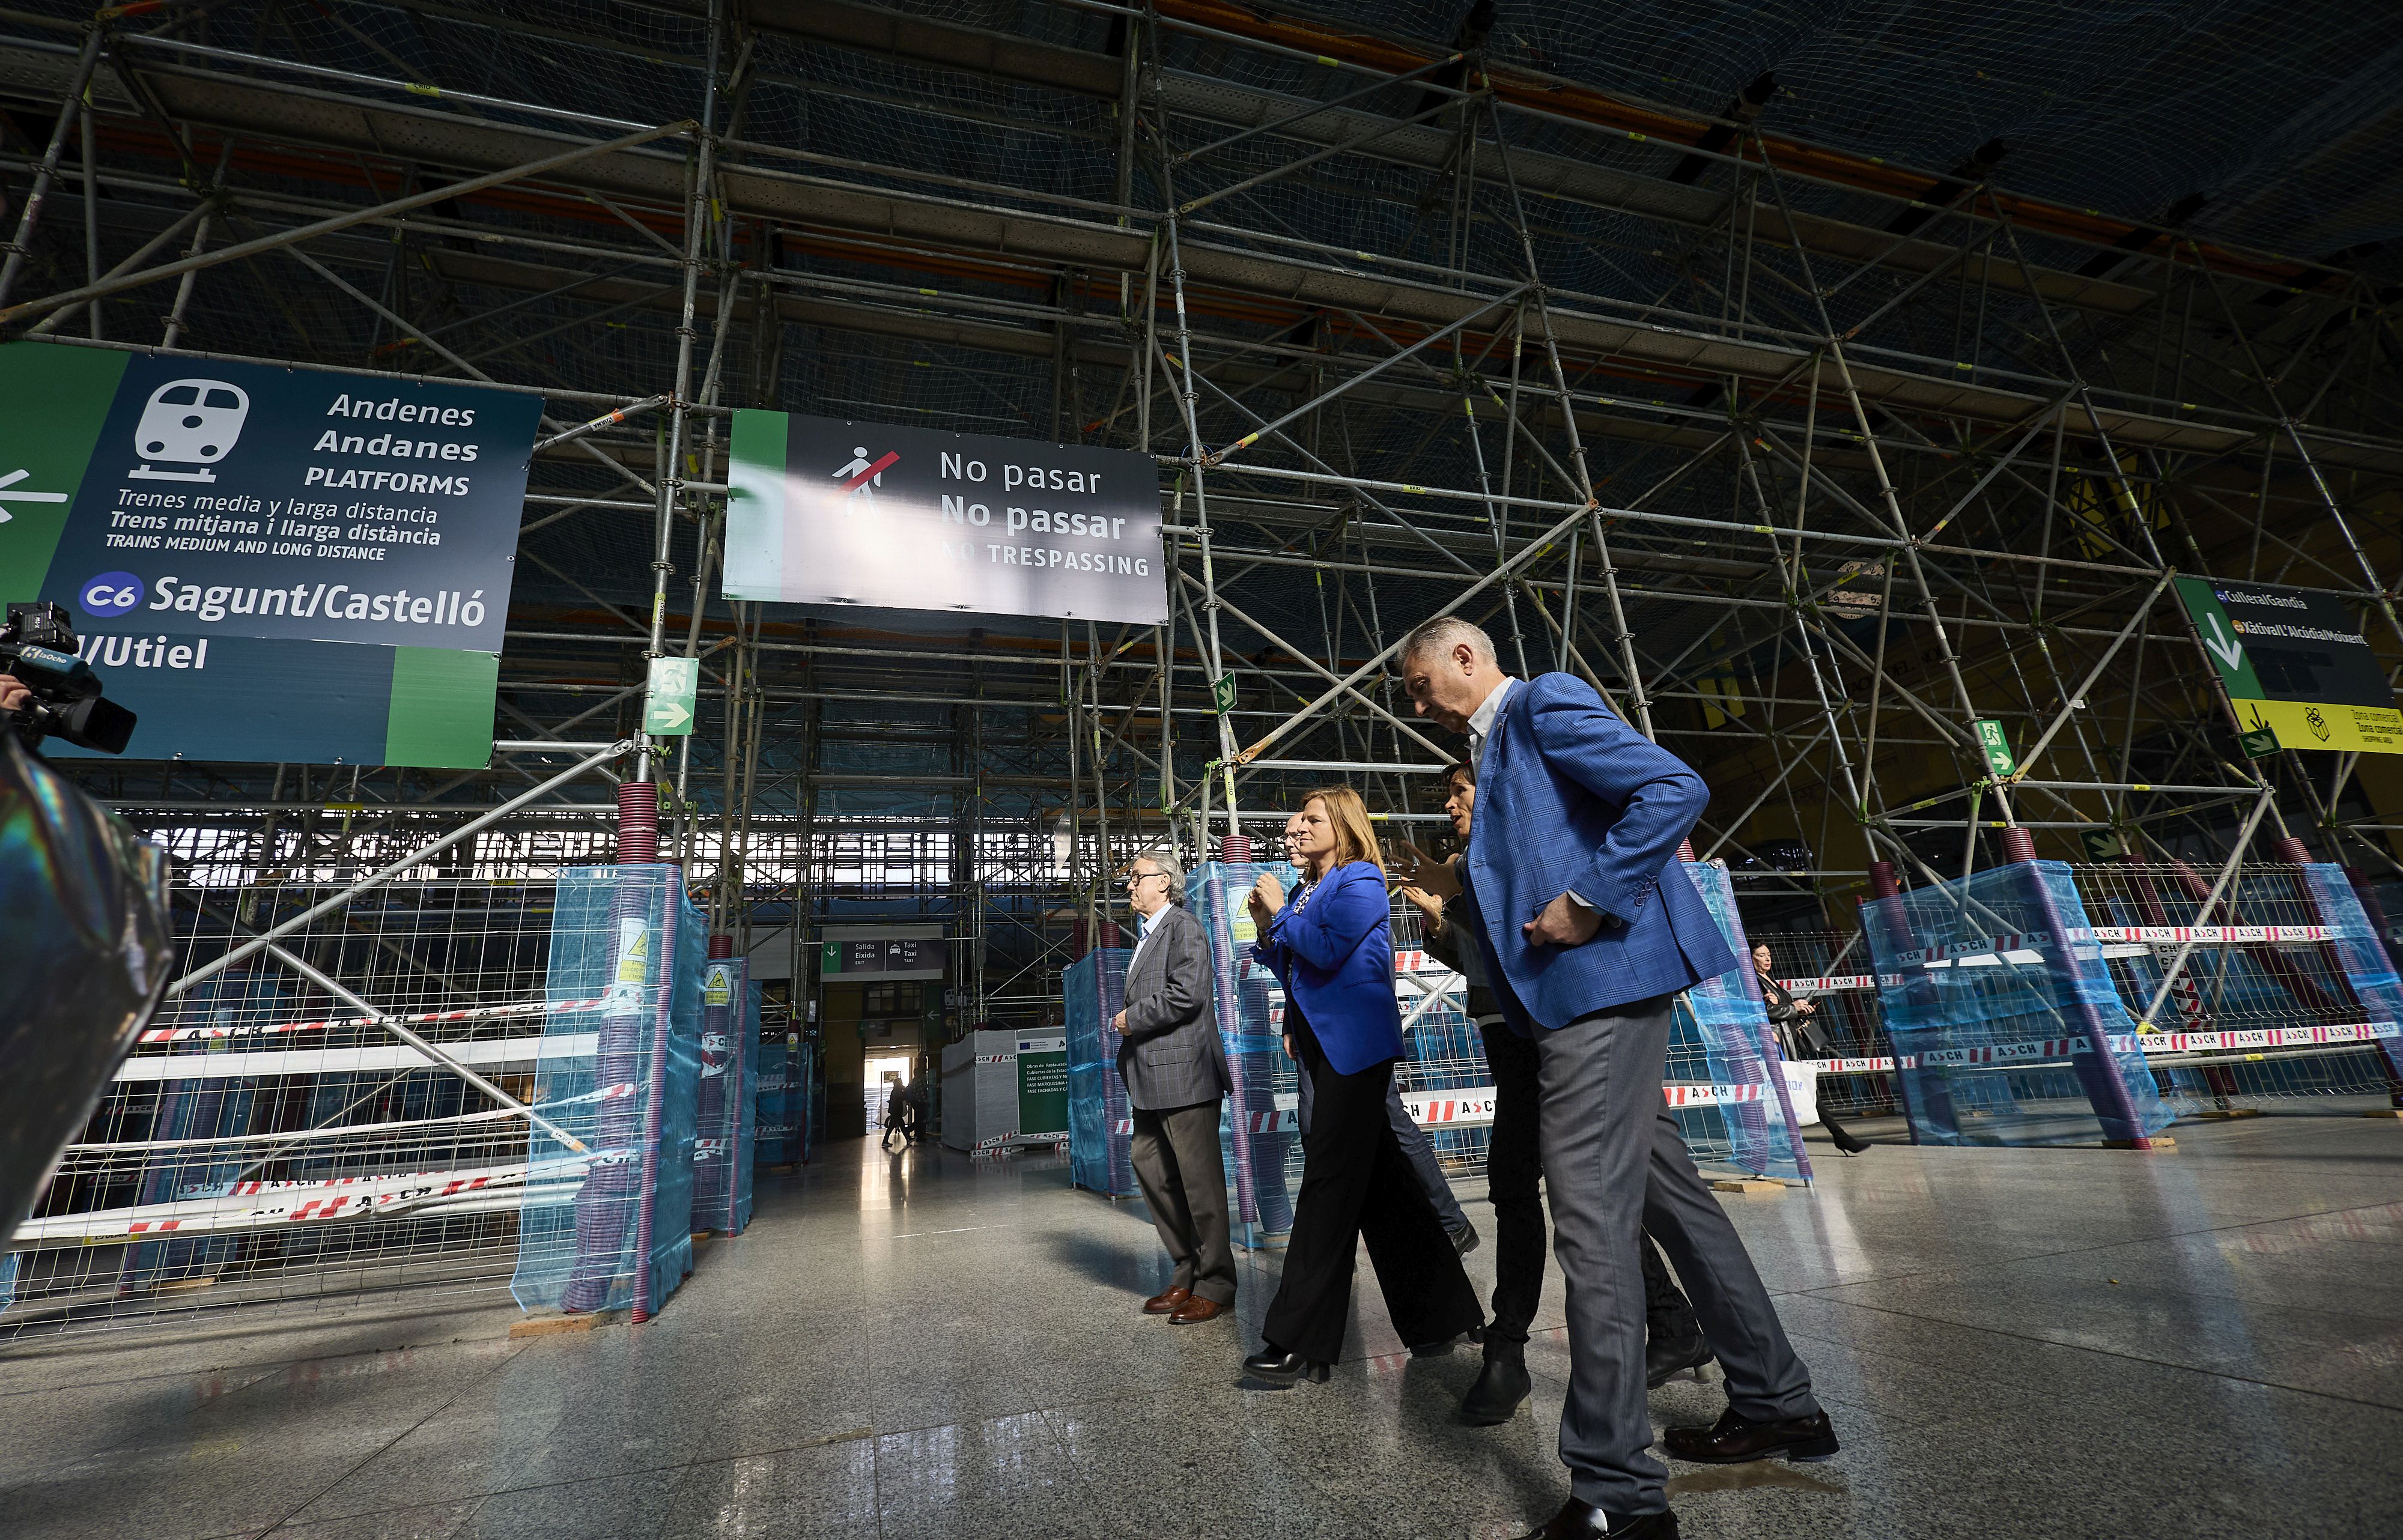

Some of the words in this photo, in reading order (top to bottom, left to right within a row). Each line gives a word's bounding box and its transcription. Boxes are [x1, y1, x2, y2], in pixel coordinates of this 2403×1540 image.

[327, 393, 475, 427] Andenes
[312, 430, 479, 462] Andanes
[305, 467, 470, 497] PLATFORMS
[940, 452, 987, 483] No
[1004, 463, 1101, 494] pasar
[118, 489, 187, 509] Trenes
[193, 494, 261, 512] media
[267, 500, 281, 517] y
[287, 498, 338, 520] larga
[345, 502, 438, 524] distancia
[941, 494, 989, 527] No
[1006, 505, 1125, 540] passar
[110, 511, 167, 529] Trens
[174, 513, 260, 536] mitjana
[266, 518, 275, 536] i
[281, 519, 340, 542] llarga
[347, 524, 441, 546] distància
[106, 534, 161, 549] TRAINS
[165, 538, 230, 552] MEDIUM
[234, 541, 267, 554] AND
[271, 542, 312, 557] LONG
[317, 545, 386, 561] DISTANCE
[943, 543, 976, 560] NO
[987, 544, 1149, 577] TRESPASSING
[85, 585, 136, 608] C6
[149, 575, 486, 628] Sagunt/Castelló
[2225, 590, 2308, 610] Cullera/Gandia
[40, 652, 67, 664] laOcho
[2351, 709, 2369, 720] Zona
[2370, 712, 2399, 723] comercial
[2356, 722, 2374, 732] Zona
[2375, 724, 2403, 735] comercial
[2094, 929, 2121, 938] ASCH
[2146, 929, 2171, 938] ASCH
[2195, 929, 2219, 937] ASCH
[2239, 928, 2262, 937] ASCH
[2283, 928, 2304, 936] ASCH
[1899, 951, 1921, 961] SCH
[1950, 940, 1988, 953] ASCH
[2028, 933, 2049, 944] AS
[2140, 1037, 2167, 1046] ASCH
[2191, 1034, 2217, 1044] ASCH
[2239, 1032, 2264, 1042] ASCH
[2286, 1029, 2309, 1039] ASCH
[2330, 1026, 2353, 1036] ASCH
[1929, 1051, 1963, 1061] ASCH
[1998, 1044, 2037, 1057] ASCH
[1693, 1086, 1728, 1098] ASCH
[1462, 1100, 1496, 1114] ASC
[984, 1137, 1000, 1146] ASCH
